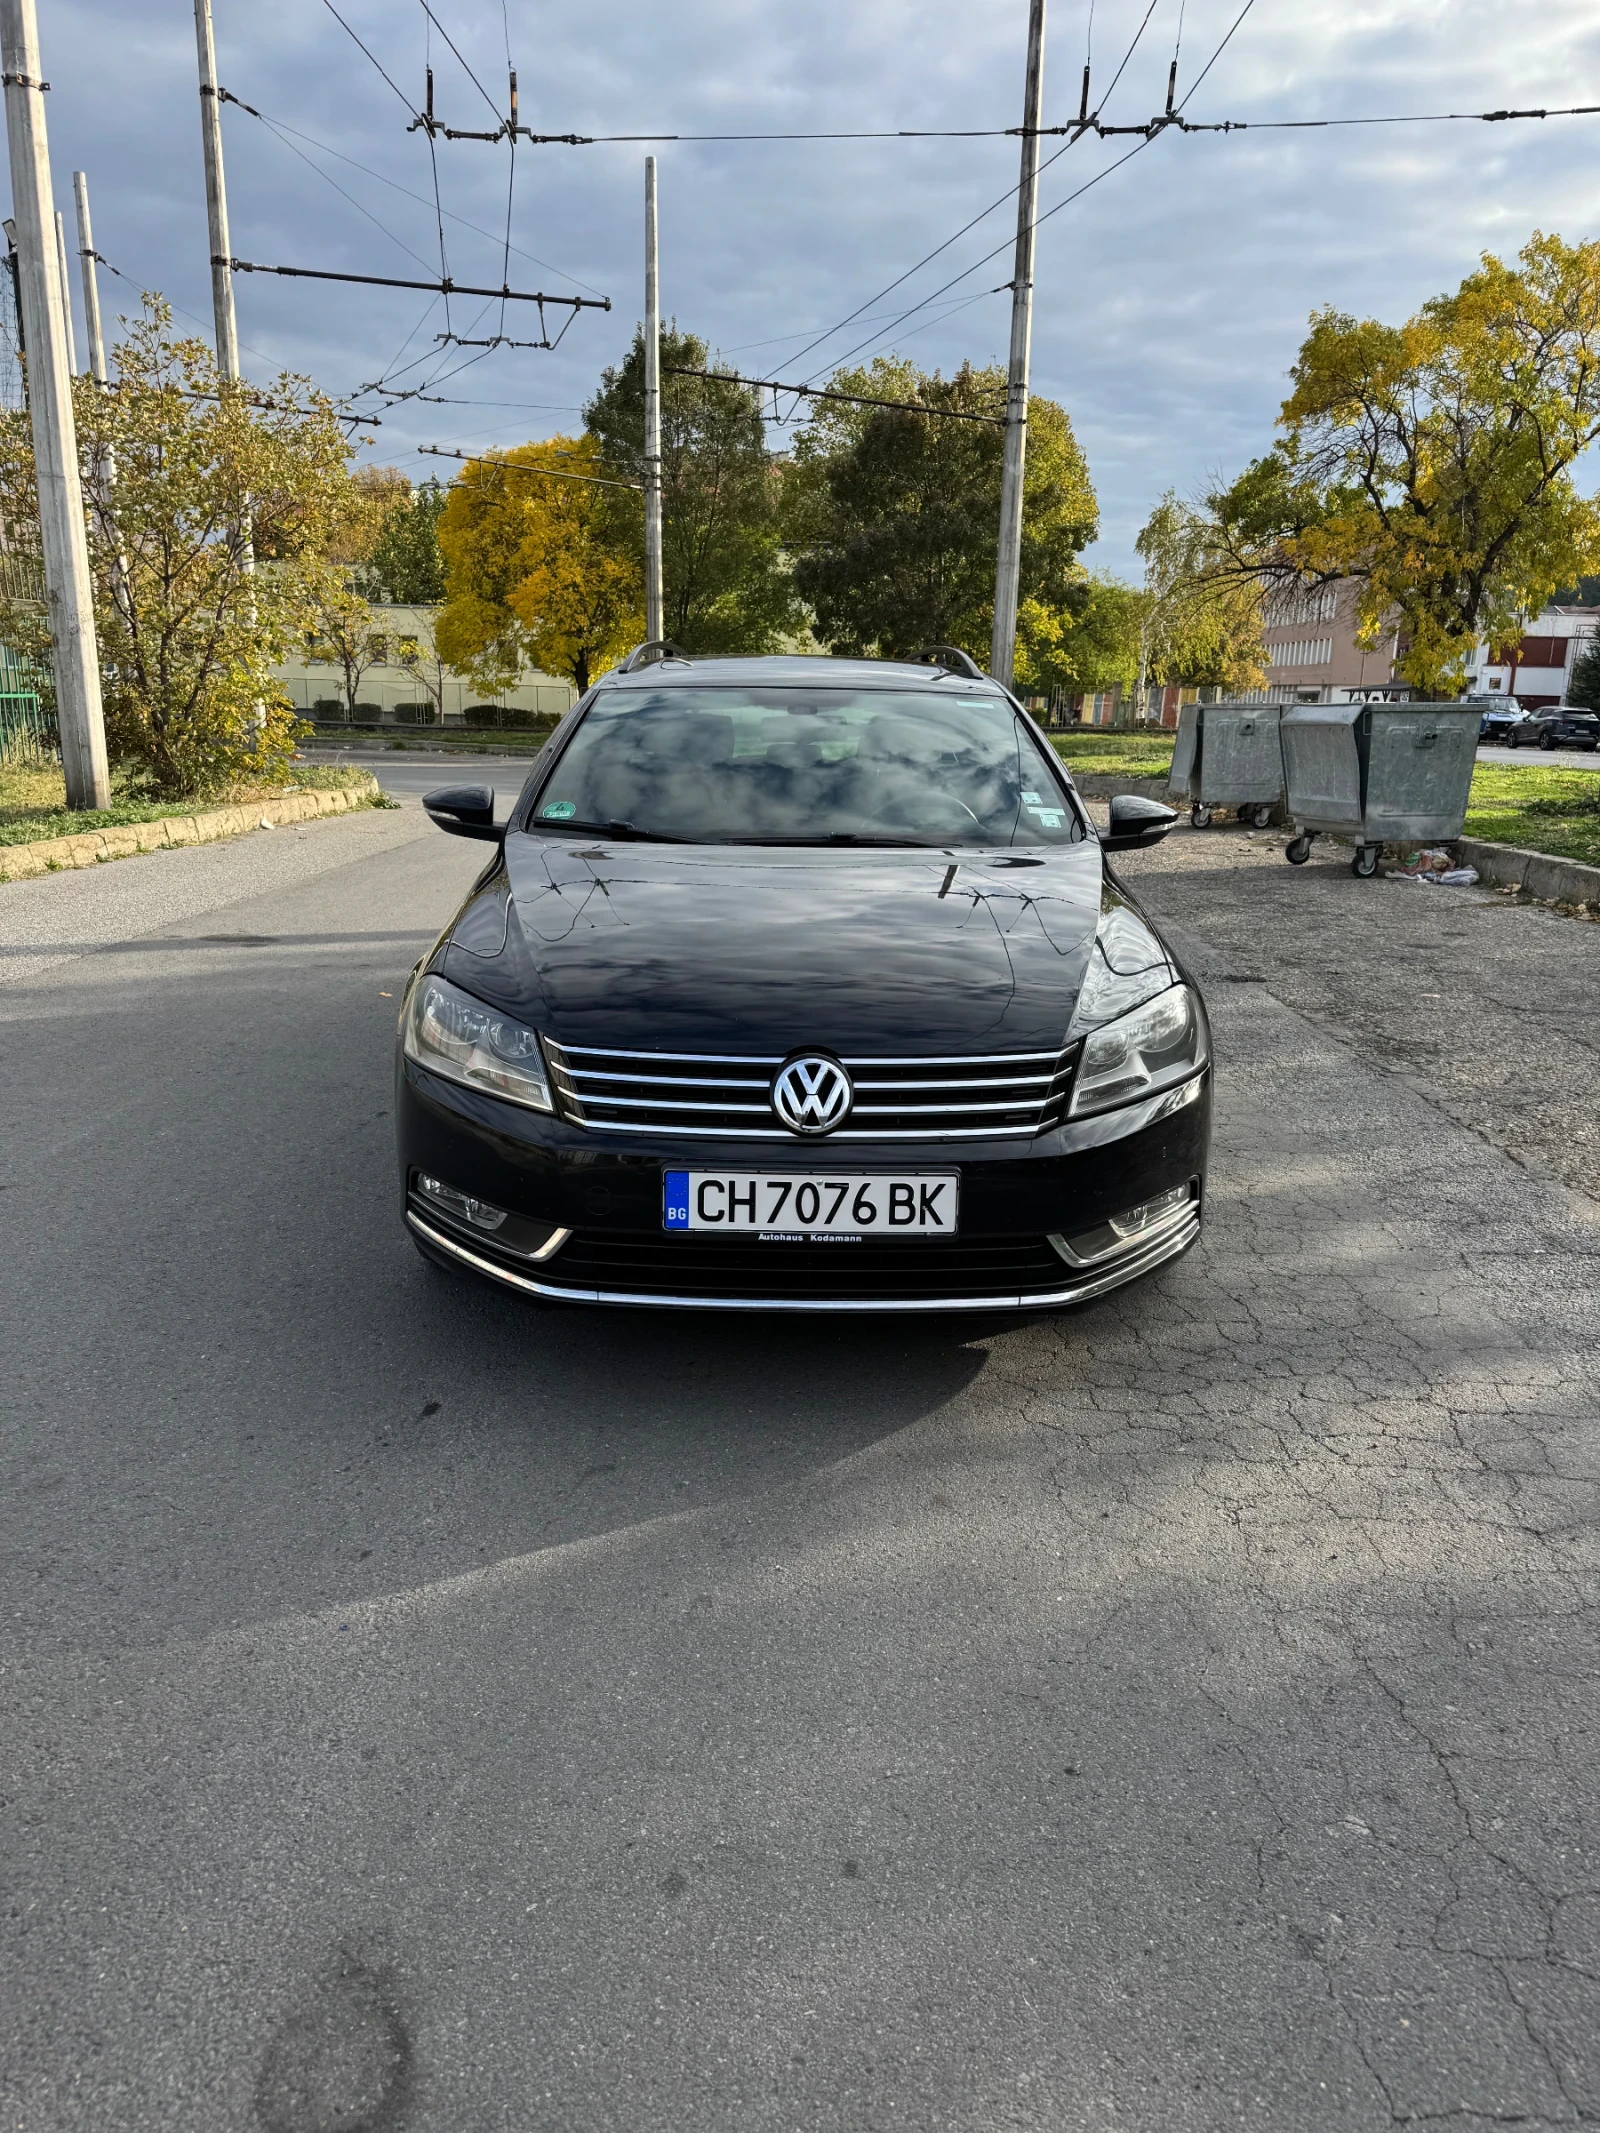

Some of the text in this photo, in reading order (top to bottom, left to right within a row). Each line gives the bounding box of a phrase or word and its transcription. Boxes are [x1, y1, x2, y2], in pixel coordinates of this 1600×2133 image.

[777, 1061, 847, 1129] VW
[667, 1207, 687, 1220] BG
[758, 1233, 862, 1242] Autohaus Kodamann
